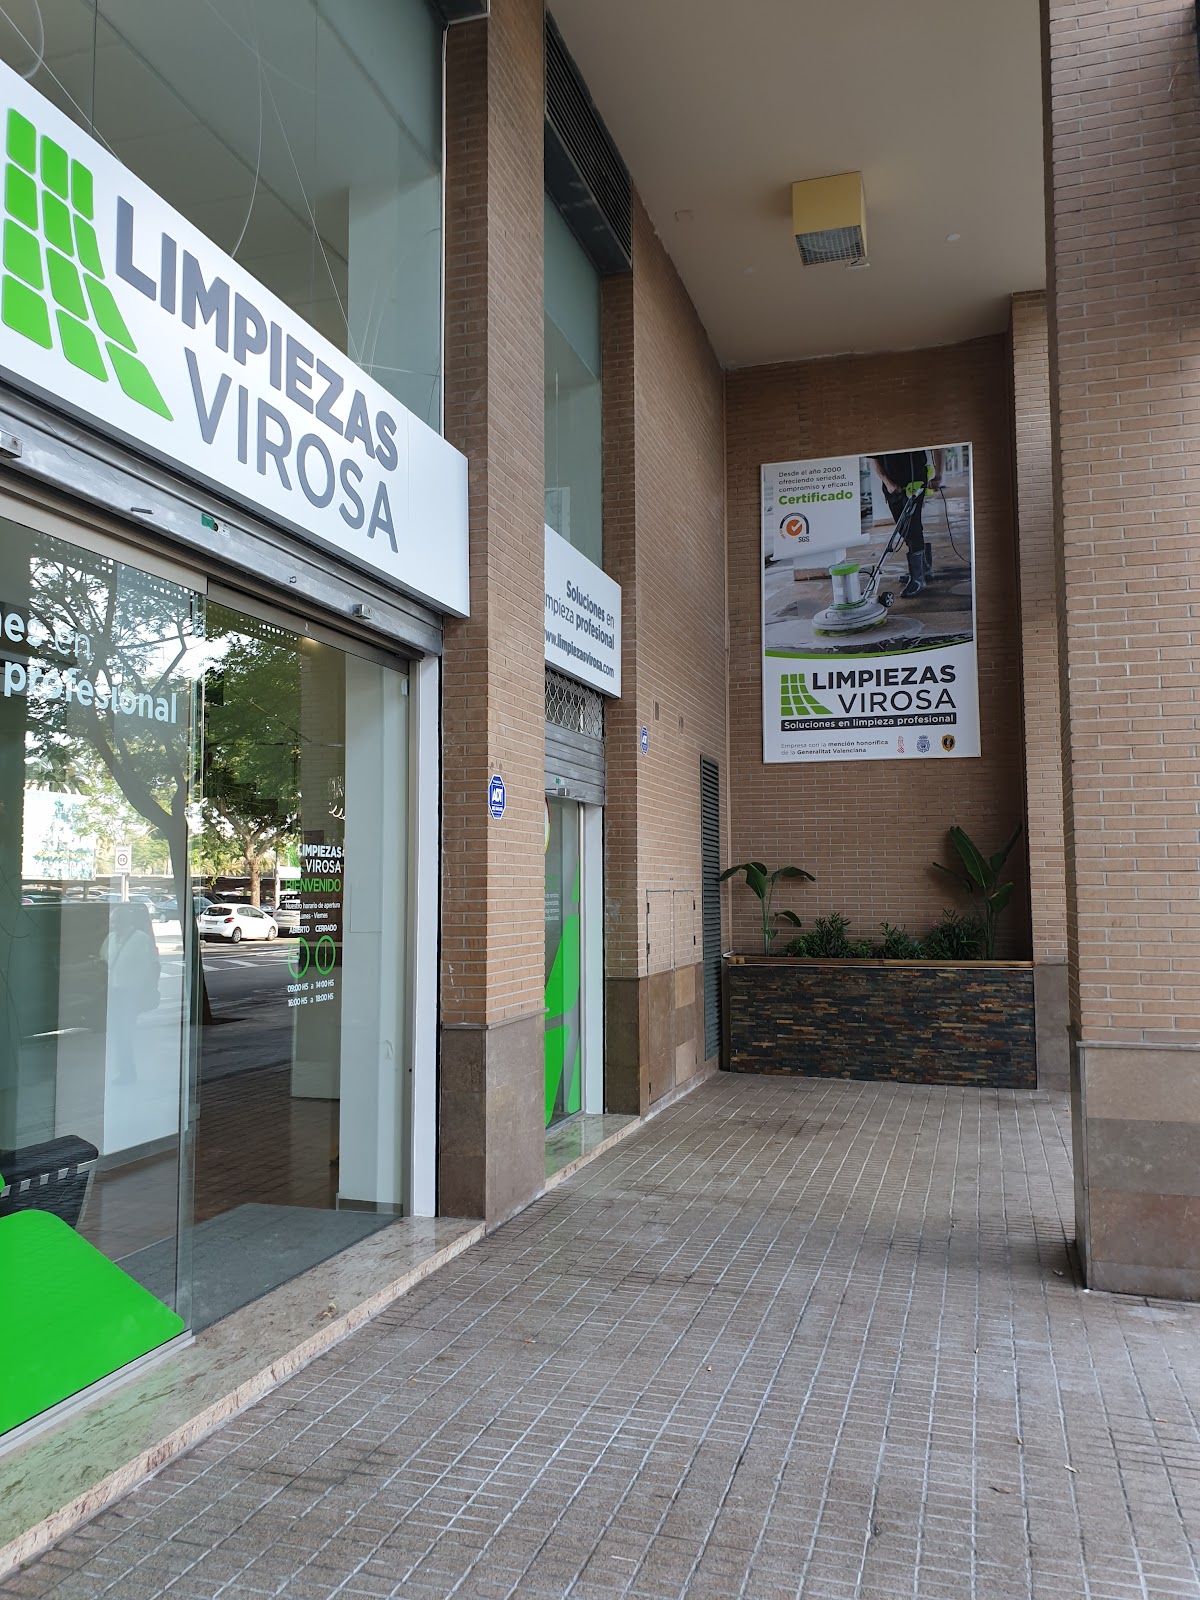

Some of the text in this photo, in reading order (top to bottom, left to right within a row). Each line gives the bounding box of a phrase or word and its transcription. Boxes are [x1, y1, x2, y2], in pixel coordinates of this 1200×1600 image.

[116, 196, 398, 472] LIMPIEZAS
[184, 346, 399, 553] VIROSA
[778, 470, 799, 478] Desde
[823, 466, 842, 474] 2000
[779, 474, 847, 485] ofreciendo seriedad,
[779, 485, 820, 493] compromiso
[828, 480, 854, 489] eficacia
[778, 490, 853, 505] Certificado
[798, 535, 810, 543] SGS
[566, 579, 615, 630] Soluciones en
[0, 611, 91, 661] es en
[576, 613, 615, 651] profesional
[812, 665, 957, 690] LIMPIEZAS
[3, 660, 178, 724] profesional
[838, 688, 957, 714] VIROSA
[784, 713, 954, 730] Soluciones en limpieza profesional
[797, 747, 831, 755] Generalitat
[297, 843, 342, 858] LIMPIEZAS
[305, 858, 342, 874] VIROSA
[285, 878, 341, 893] BIENVENIDO
[285, 902, 302, 910] Nuestro
[288, 924, 338, 935] ABIERTO CERRADO
[287, 983, 302, 993] 09:00
[302, 982, 309, 991] HS
[328, 979, 335, 987] HS
[300, 996, 308, 1005] HS
[328, 992, 335, 1001] HS
